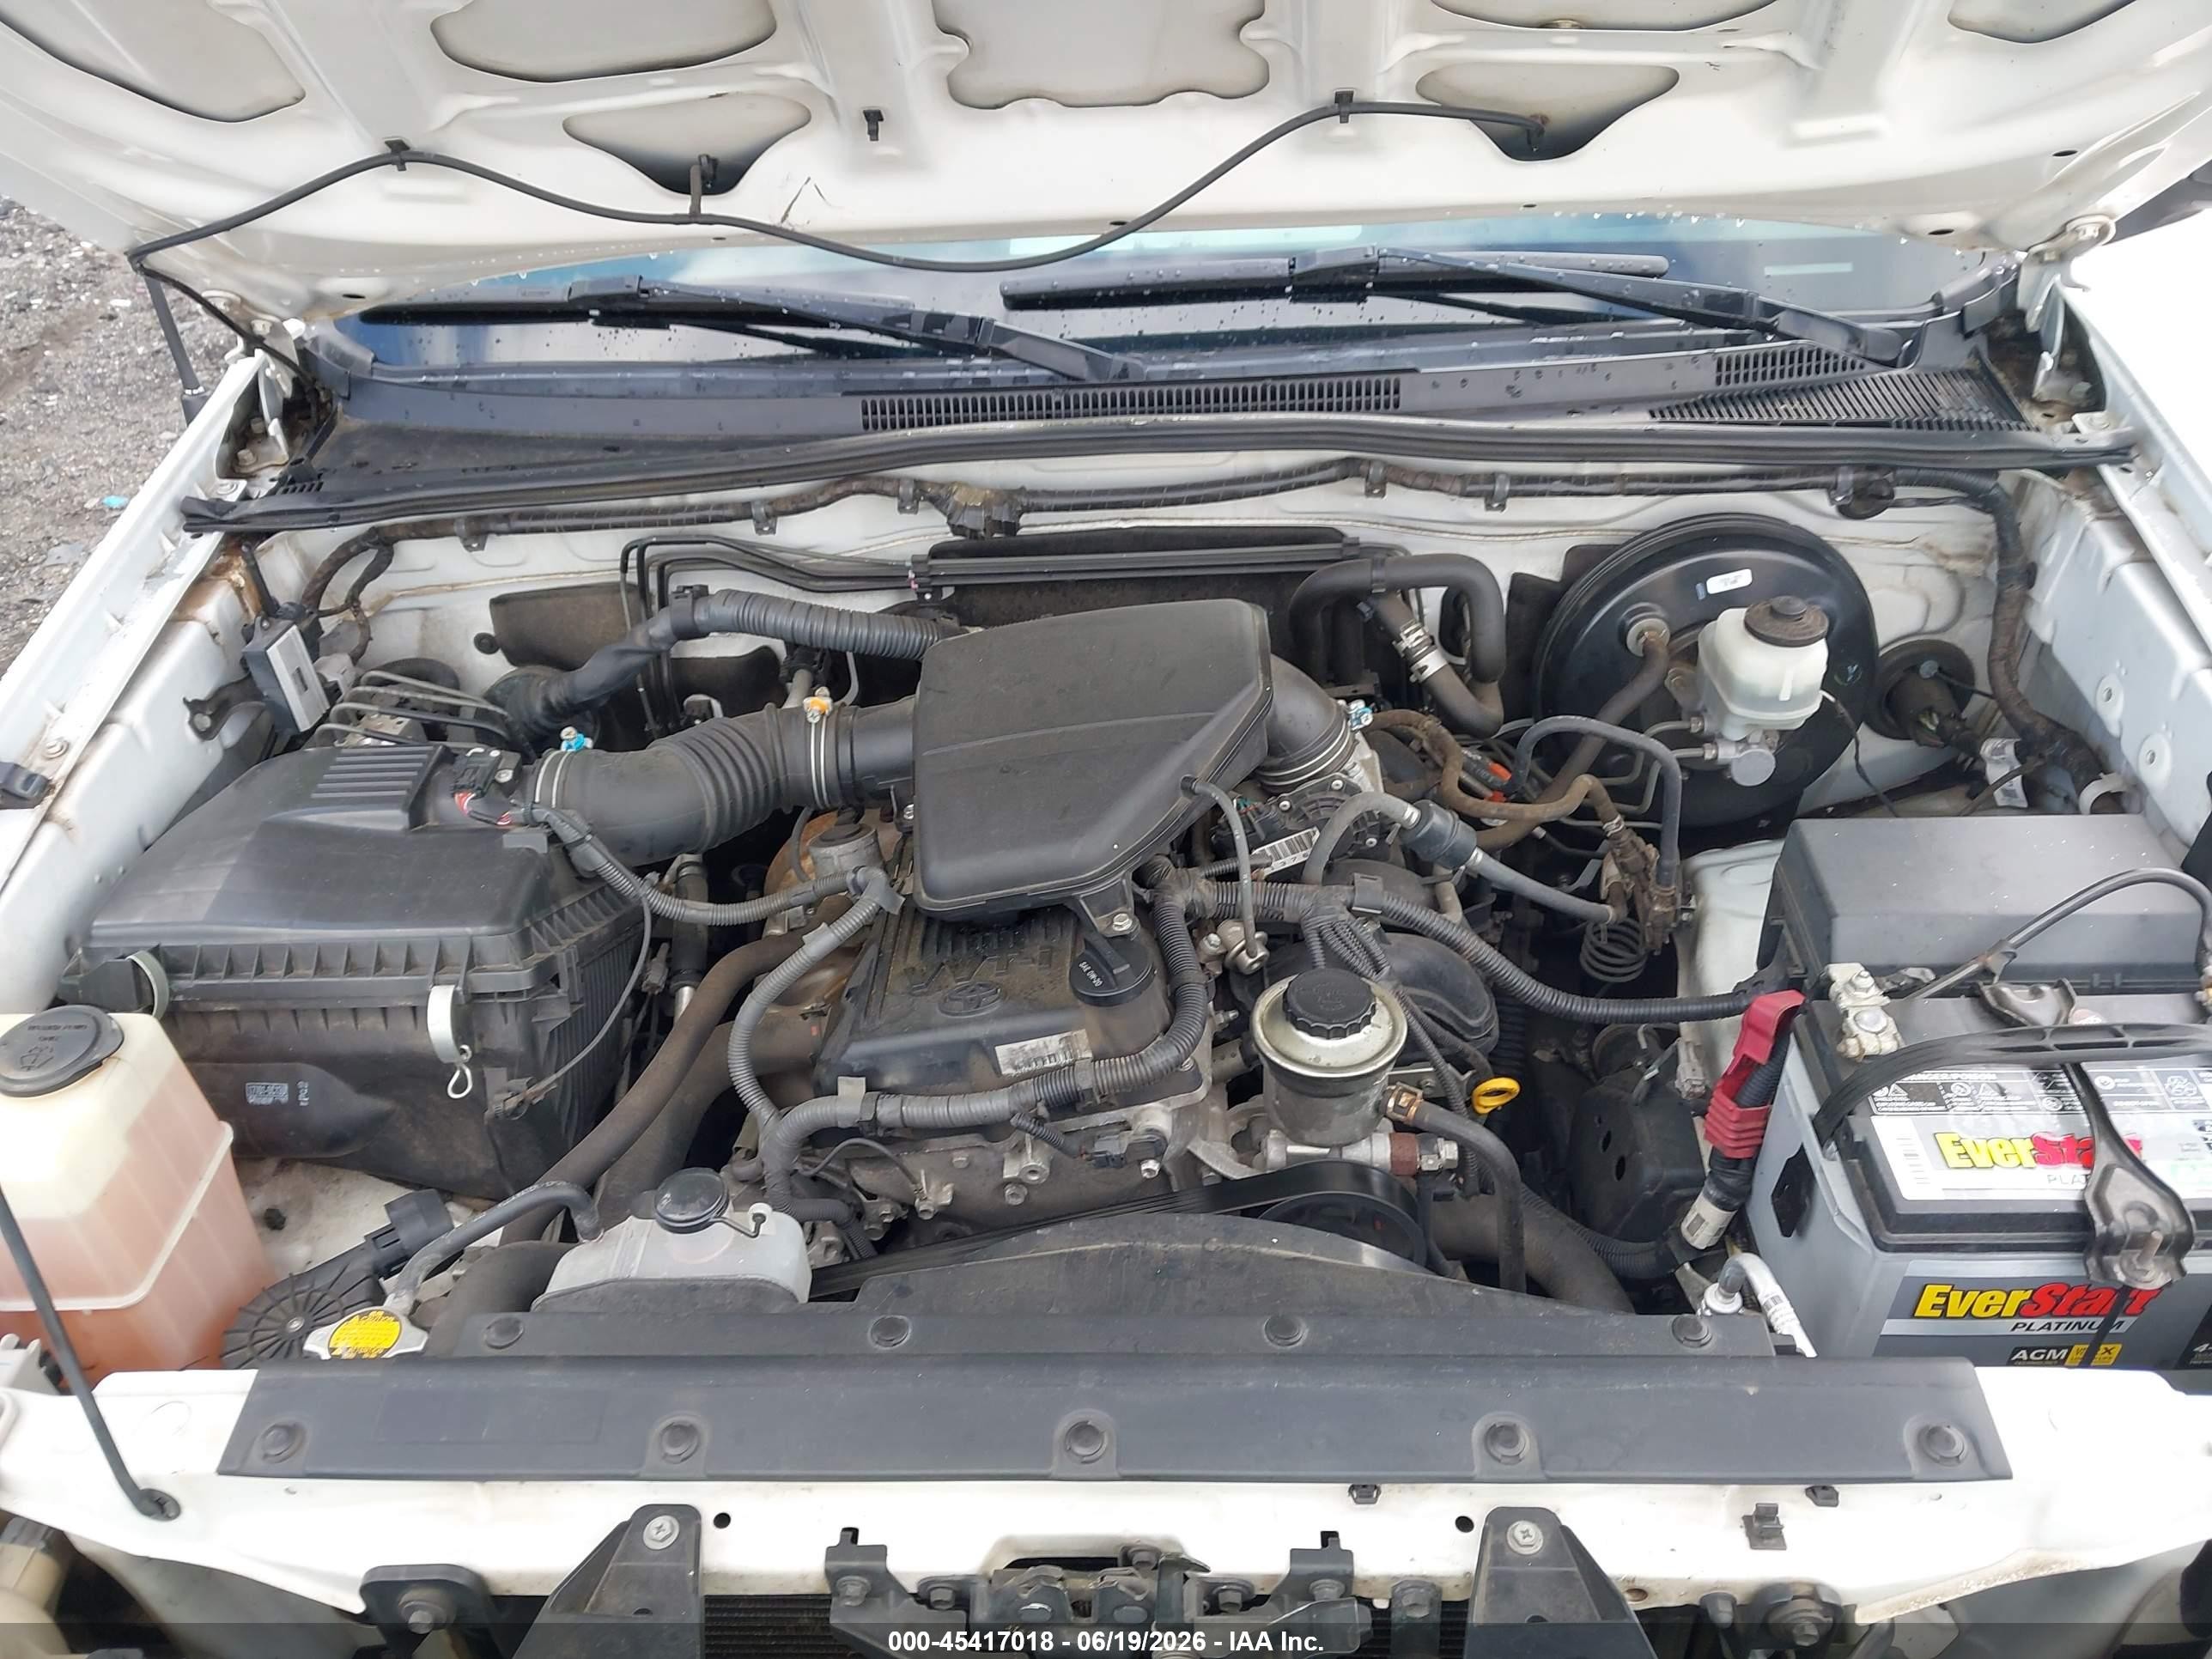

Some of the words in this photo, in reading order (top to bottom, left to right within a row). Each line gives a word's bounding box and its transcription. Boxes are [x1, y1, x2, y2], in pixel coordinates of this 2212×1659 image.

[1079, 961, 1091, 973] SAE
[1086, 969, 1103, 988] 0W-20
[1933, 1131, 2142, 1169] EverSta
[2010, 1348, 2069, 1361] AGM
